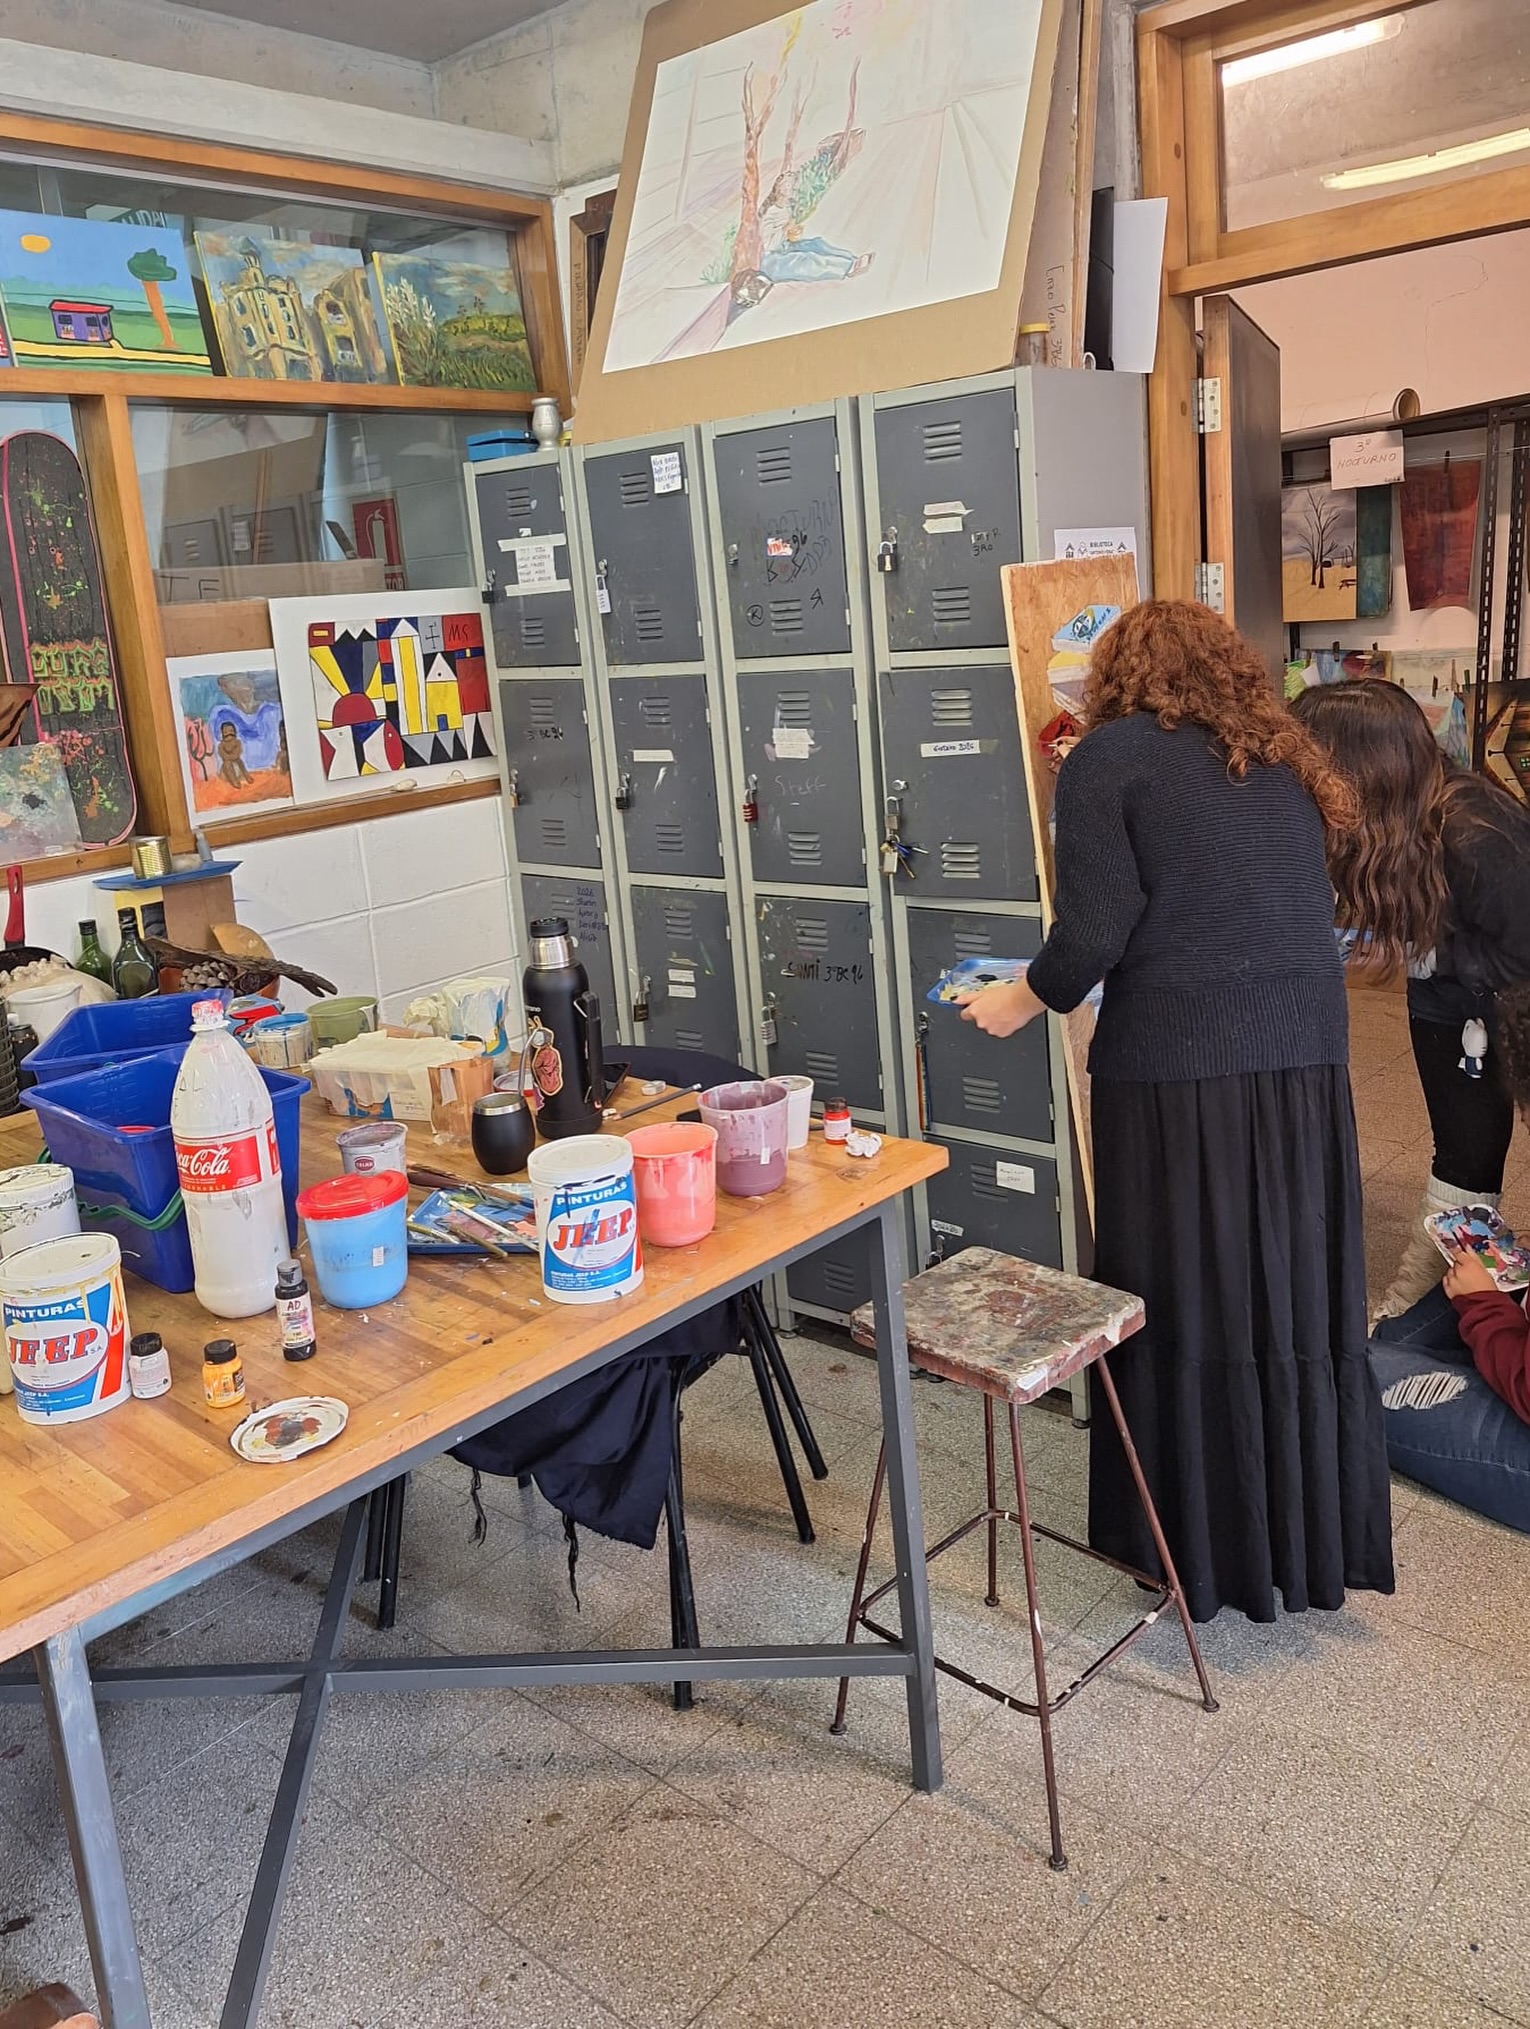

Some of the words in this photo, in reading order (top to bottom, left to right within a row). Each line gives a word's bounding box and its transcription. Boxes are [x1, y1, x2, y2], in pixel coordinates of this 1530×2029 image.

[1337, 452, 1397, 469] NOCTURNO
[449, 624, 470, 643] MS
[556, 1180, 628, 1206] PINTURAS
[552, 1207, 633, 1251] JEEP
[4, 1299, 84, 1320] PINTURAS
[287, 1300, 301, 1311] AD
